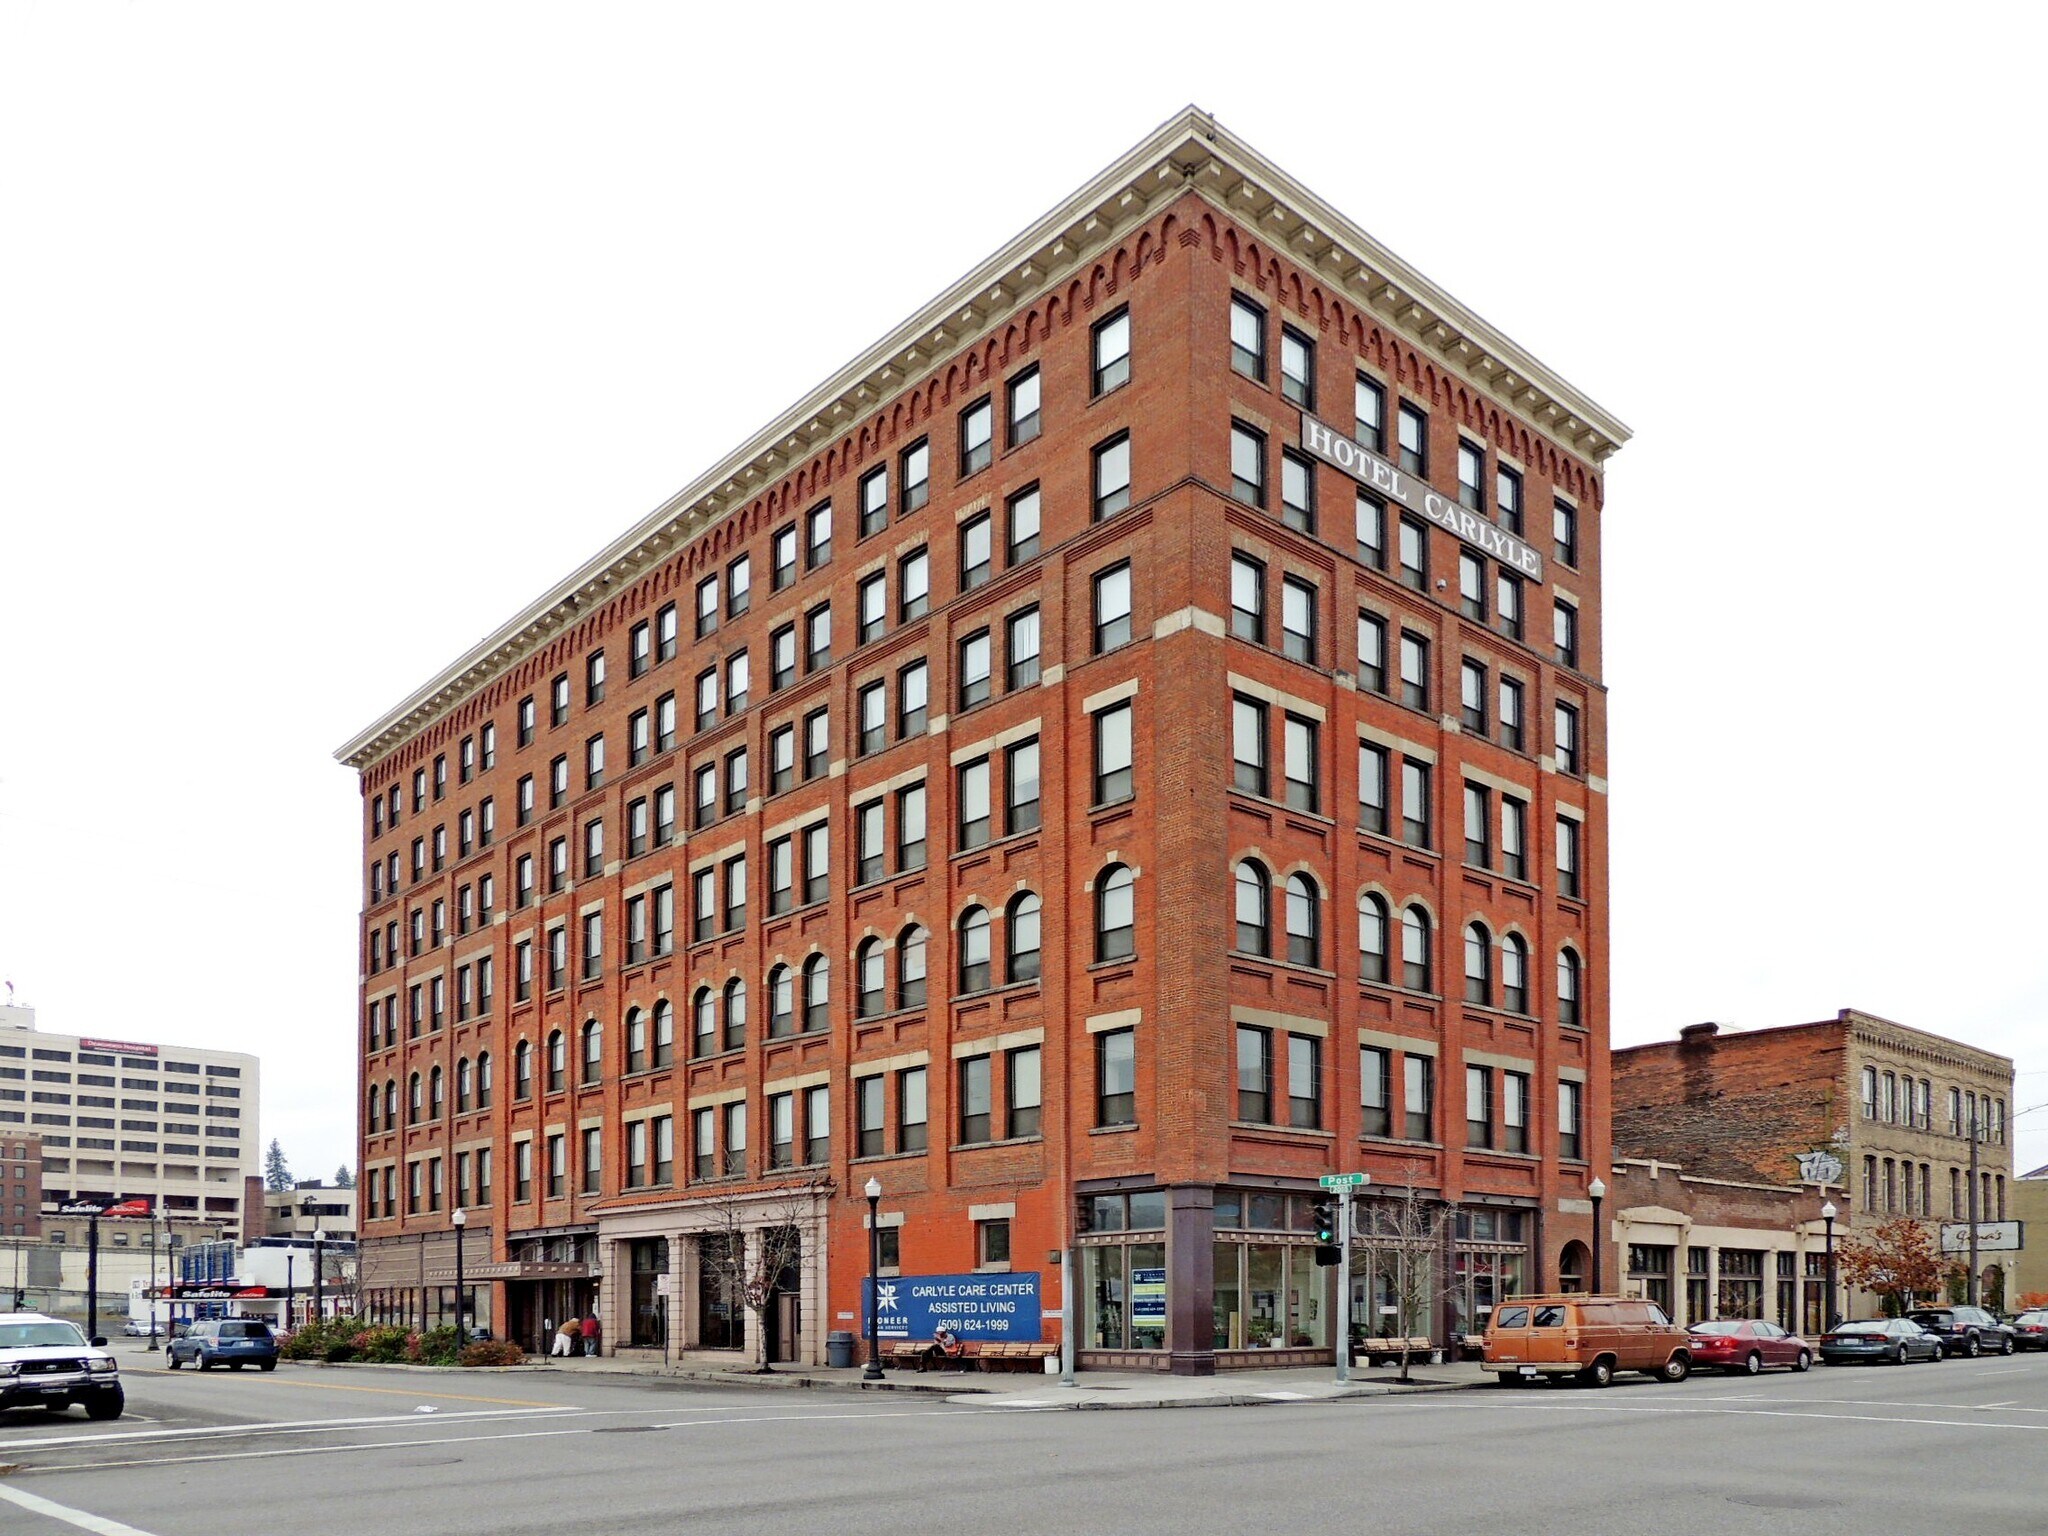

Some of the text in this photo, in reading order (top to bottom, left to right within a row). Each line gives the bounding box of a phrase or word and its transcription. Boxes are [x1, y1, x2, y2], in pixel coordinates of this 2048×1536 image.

[1308, 421, 1537, 574] HOTEL CARLYLE
[1328, 1176, 1353, 1185] Post
[61, 1204, 103, 1213] Safelite
[182, 1290, 231, 1298] Safelite
[912, 1283, 1034, 1297] CARLYLE CARE CENTER
[928, 1301, 1016, 1313] ASSISTED LIVING
[868, 1316, 908, 1324] ONEER
[937, 1319, 1009, 1331] (509) 624-1999
